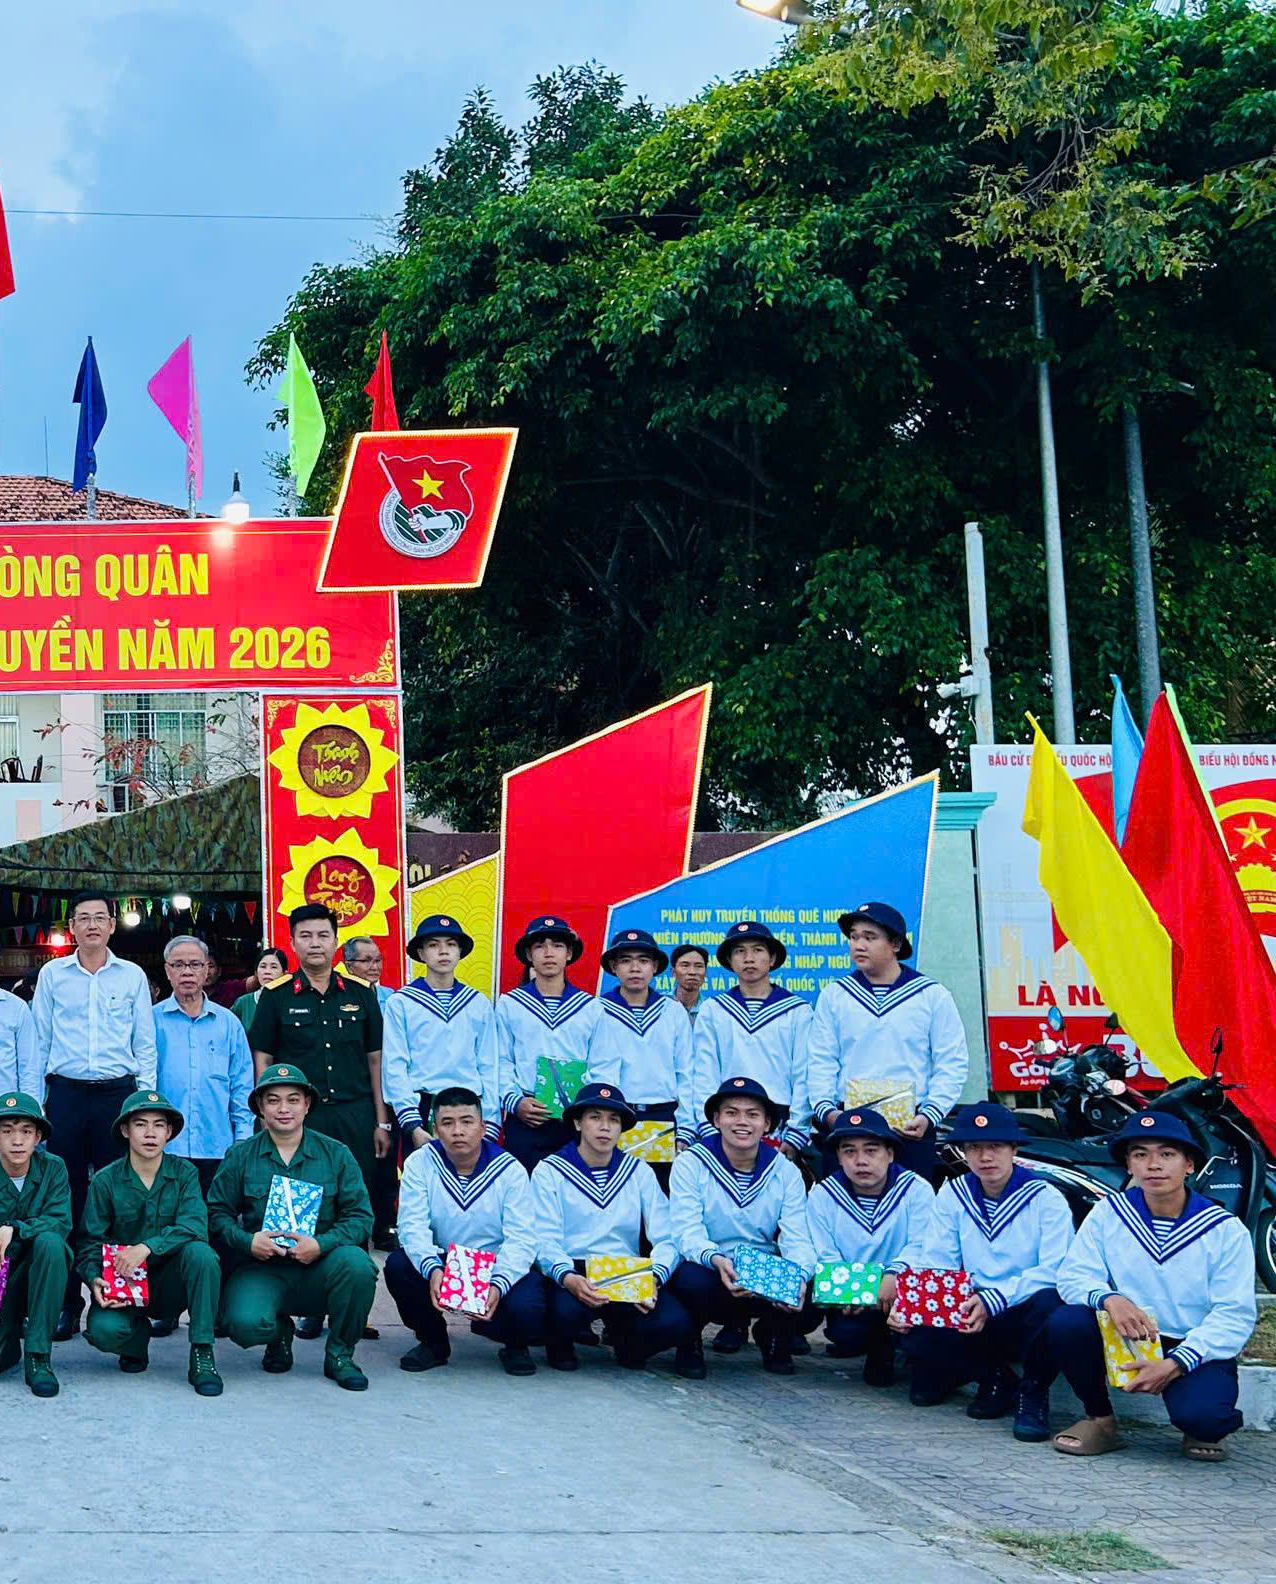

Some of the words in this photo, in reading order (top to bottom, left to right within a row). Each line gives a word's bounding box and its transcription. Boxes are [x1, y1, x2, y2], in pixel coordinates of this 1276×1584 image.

[95, 544, 209, 601] QUÂN
[118, 619, 215, 670] NĂM
[229, 626, 331, 669] 2026
[1070, 751, 1096, 767] QUỐC
[1224, 752, 1239, 768] HỘI
[317, 863, 365, 893] Long
[661, 907, 689, 923] PHÁT
[692, 909, 713, 922] HUY
[715, 905, 757, 922] TRUYỀN
[759, 905, 795, 924] THỐNG
[798, 907, 820, 925] QUÊ
[800, 930, 837, 946] THÀNH
[795, 953, 824, 972] NHẬP
[711, 975, 726, 990] VÀ
[786, 973, 815, 992] QUỐC
[1017, 980, 1057, 1006] LÀ
